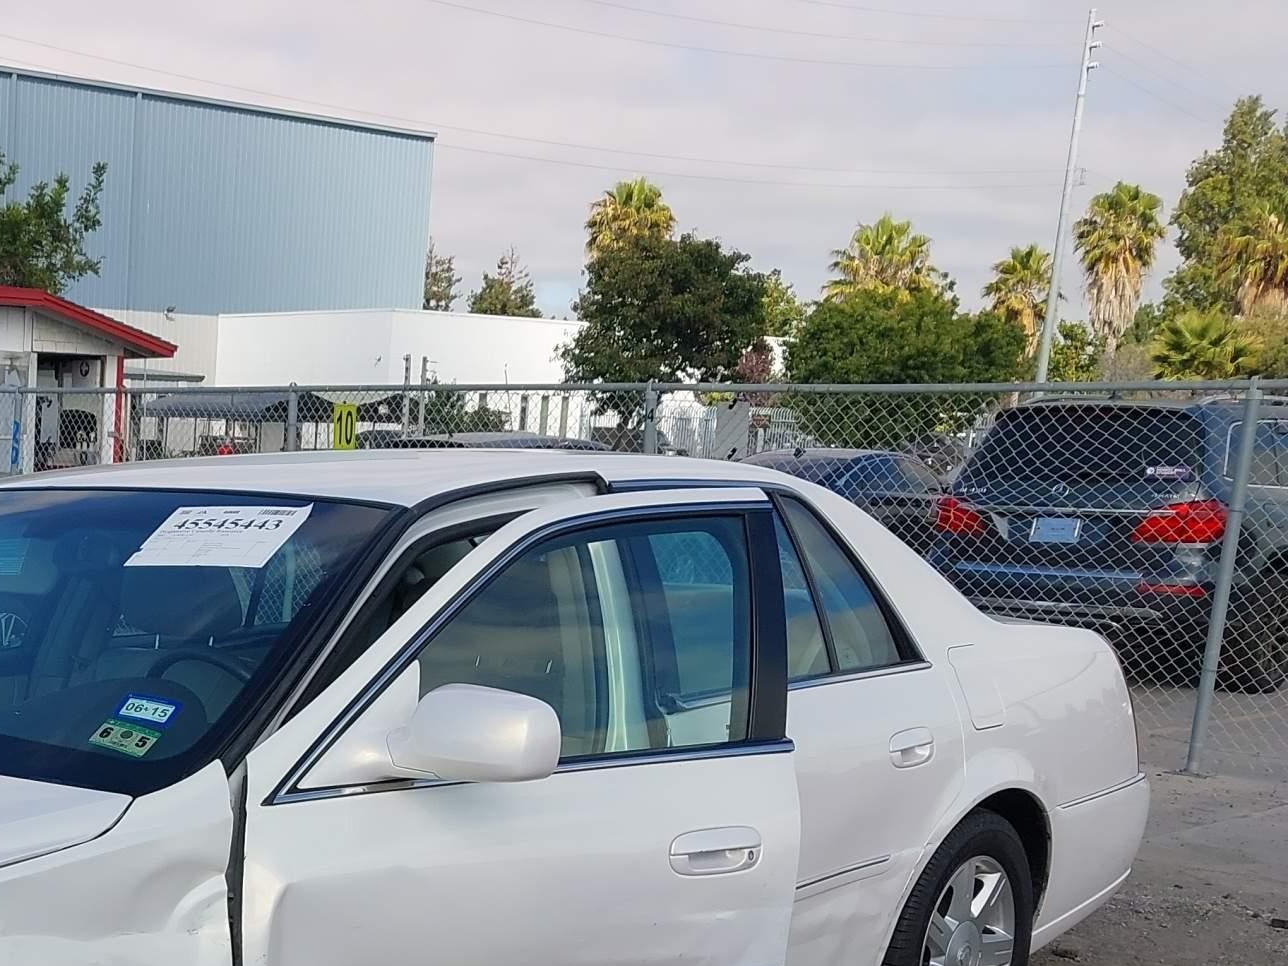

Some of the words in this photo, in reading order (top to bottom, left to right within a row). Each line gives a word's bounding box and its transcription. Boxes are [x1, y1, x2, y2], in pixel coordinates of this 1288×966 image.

[337, 410, 354, 445] 10
[173, 518, 283, 531] 45545443
[98, 726, 114, 739] 6
[134, 735, 150, 748] 5
